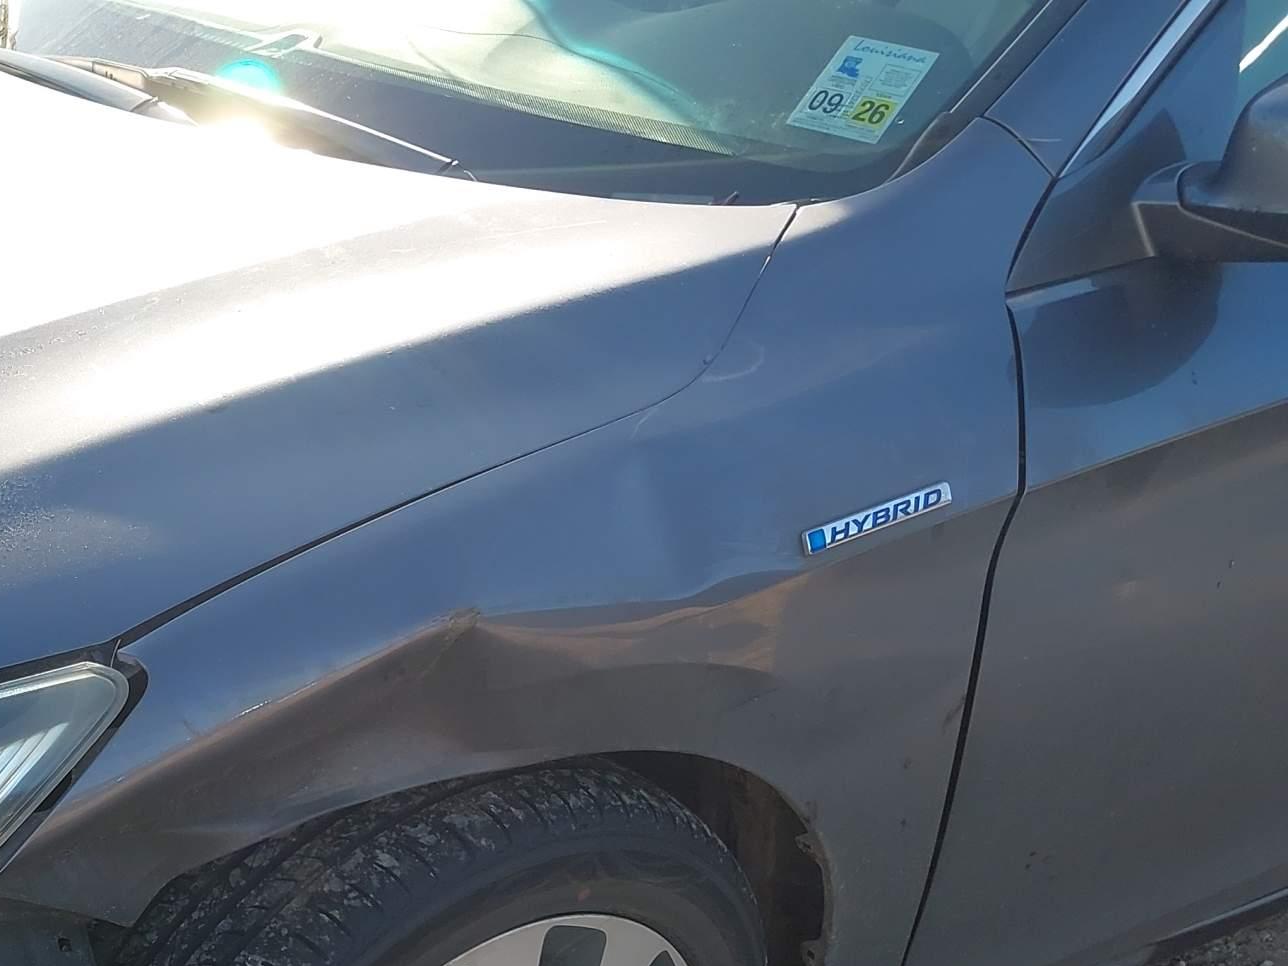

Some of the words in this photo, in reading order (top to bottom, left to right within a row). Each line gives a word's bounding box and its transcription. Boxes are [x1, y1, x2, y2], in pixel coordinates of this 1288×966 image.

[807, 90, 844, 114] 09
[852, 100, 890, 125] 26
[829, 488, 942, 546] HYBRID
